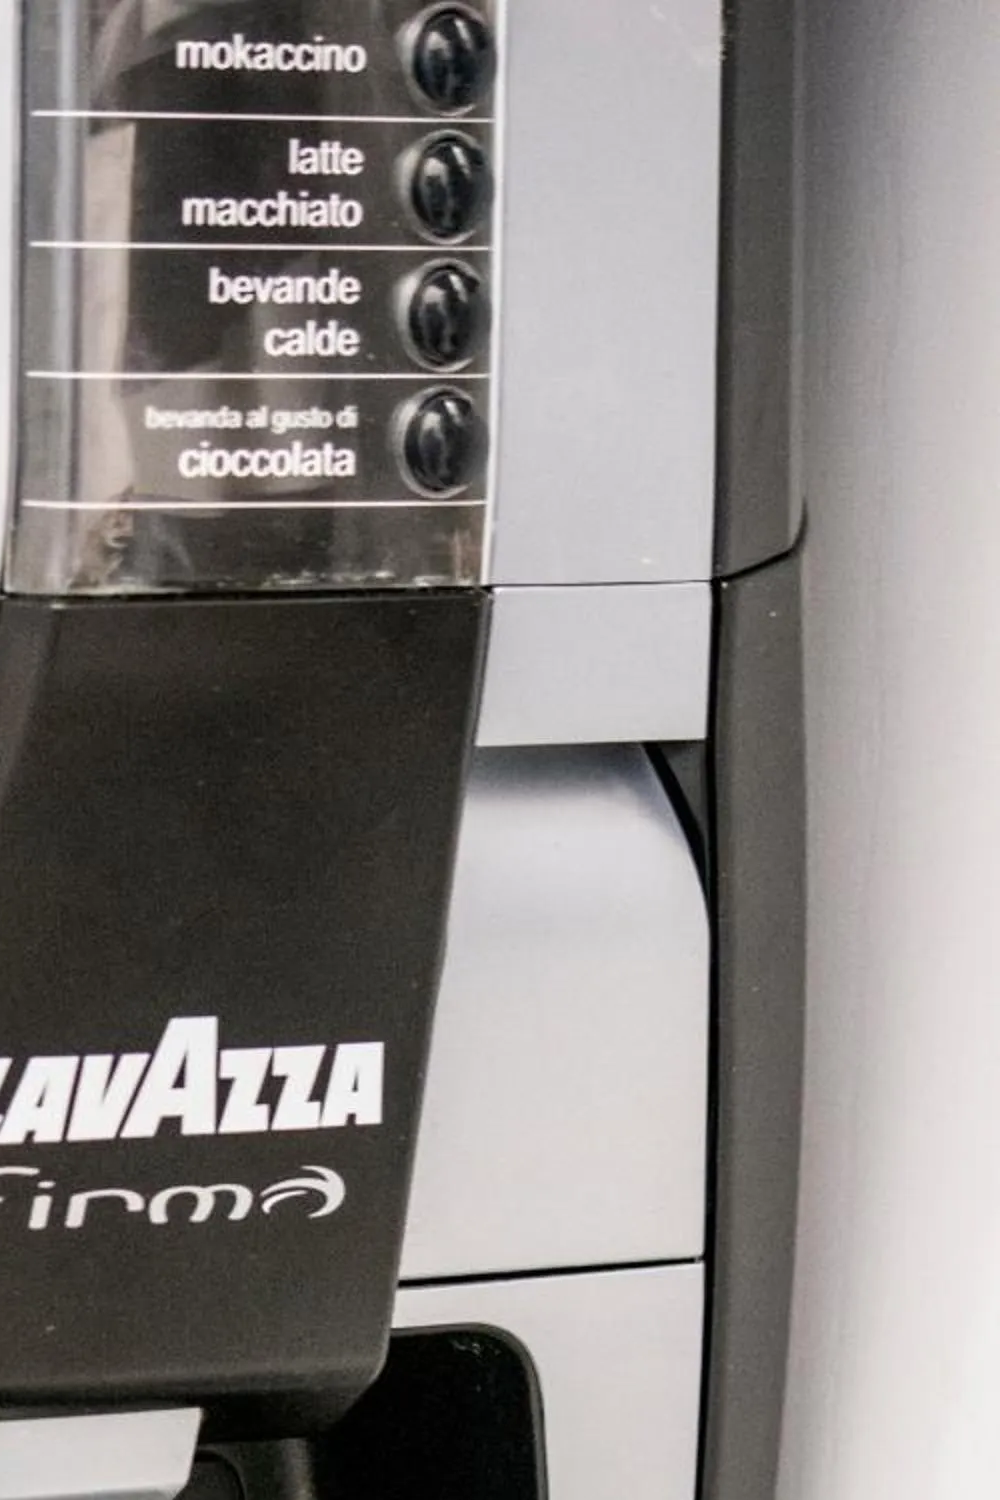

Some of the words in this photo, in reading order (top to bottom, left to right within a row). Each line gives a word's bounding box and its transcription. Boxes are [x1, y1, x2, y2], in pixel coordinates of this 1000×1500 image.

[175, 33, 367, 73] mokaccino
[288, 138, 365, 175] latte
[181, 190, 363, 227] macchiato
[208, 266, 362, 305] bevande
[264, 319, 361, 357] calde
[144, 405, 242, 429] bevanda
[246, 406, 268, 428] al
[270, 407, 333, 434] gusto
[335, 405, 358, 428] di
[177, 440, 356, 478] cioccolata
